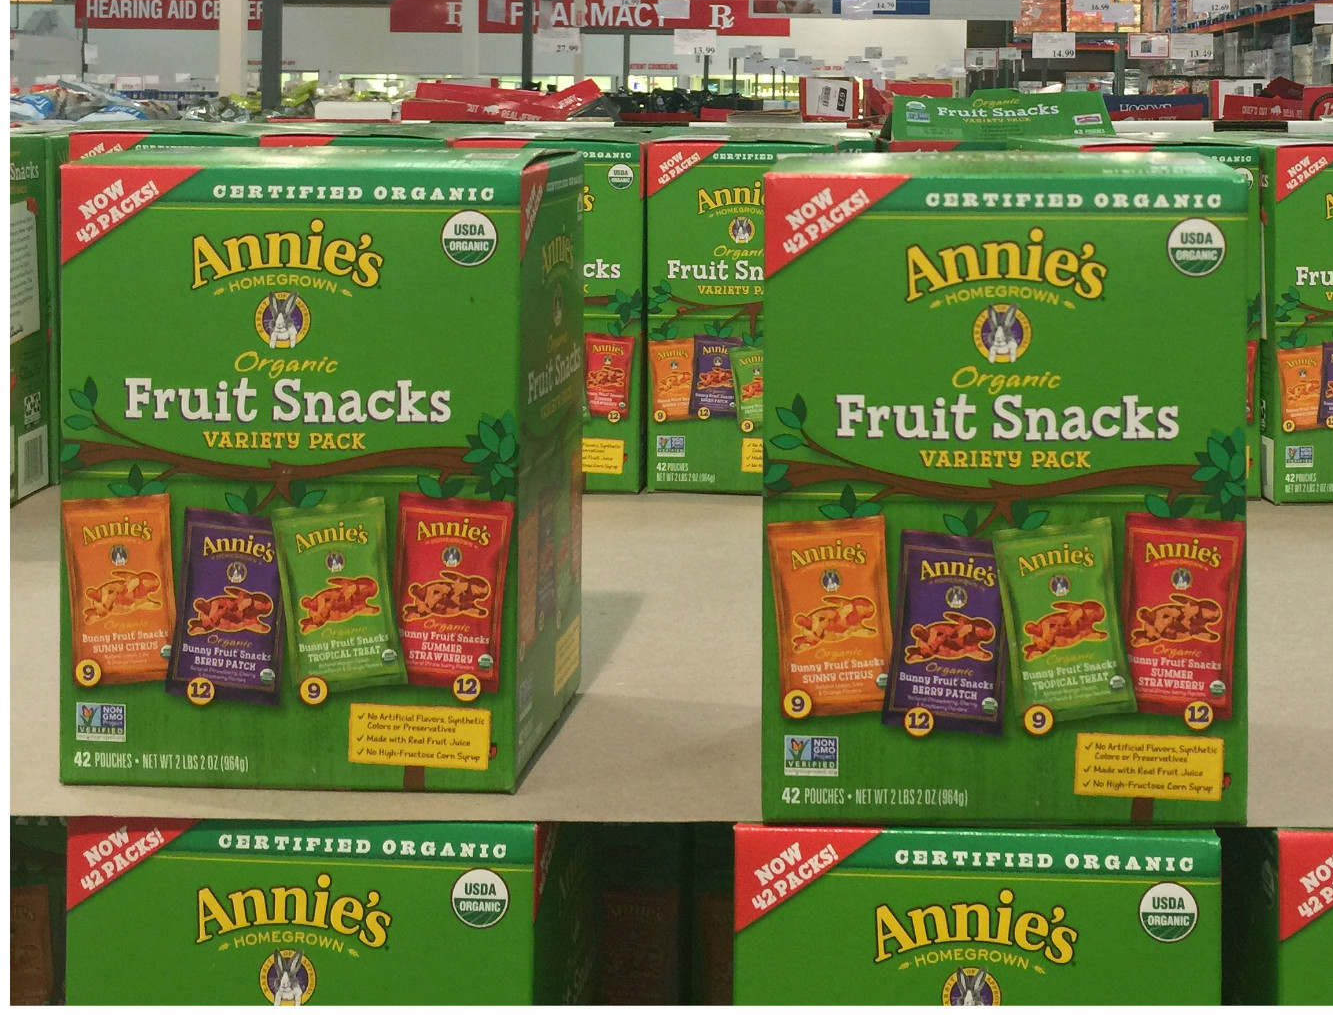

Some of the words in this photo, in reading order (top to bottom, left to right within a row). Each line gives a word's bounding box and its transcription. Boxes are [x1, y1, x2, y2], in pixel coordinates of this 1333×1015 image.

[167, 0, 197, 19] AID
[693, 46, 716, 55] 13.99
[1052, 50, 1075, 58] 14.99
[937, 107, 983, 117] Fruit
[992, 104, 1060, 117] Snacks
[213, 184, 364, 200] CERTIFIED
[373, 185, 496, 202] ORGANIC
[925, 191, 1083, 209] CERTIFIED
[1093, 191, 1223, 209] ORGANIC
[453, 222, 486, 238] USDA
[190, 218, 384, 290] Annie's
[449, 239, 490, 253] ORGANIC
[904, 226, 1108, 302] Annie's
[227, 274, 338, 295] HOMEGROWN
[233, 350, 339, 379] Organic
[123, 377, 258, 422] Fruit
[272, 378, 452, 424] Snacks
[835, 393, 977, 440] Fruit
[992, 394, 1181, 441] Snacks
[202, 431, 301, 451] VARIETY
[308, 432, 367, 451] PACK
[73, 750, 92, 768] 42
[94, 751, 133, 769] POUCHES
[141, 754, 158, 770] NET
[160, 754, 173, 770] WT
[175, 754, 183, 770] 2
[183, 754, 199, 770] LBS
[200, 755, 207, 771] 2
[208, 755, 220, 771] OZ
